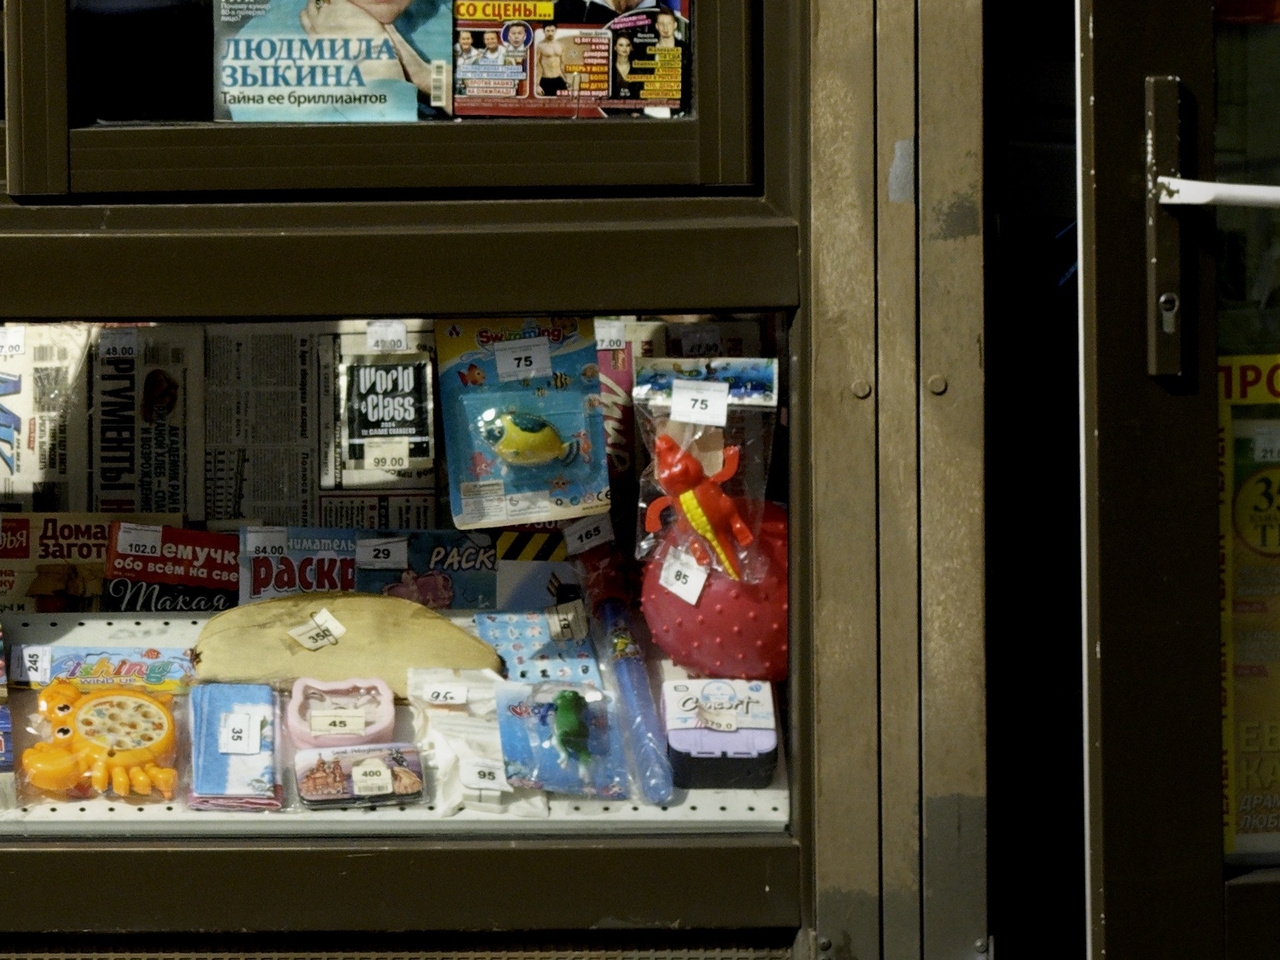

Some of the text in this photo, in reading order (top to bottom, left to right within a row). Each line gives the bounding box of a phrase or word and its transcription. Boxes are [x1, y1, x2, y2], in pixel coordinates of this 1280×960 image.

[457, 2, 552, 21] СО СЦЕНЫ...
[221, 38, 399, 64] ЛЮДМИЛА
[221, 65, 366, 88] ЗЫКИНА
[221, 91, 387, 107] Тайна ее бриллиантов
[514, 355, 534, 368] 75
[358, 365, 415, 395] World
[367, 395, 415, 422] Class
[690, 398, 709, 410] 75
[373, 456, 405, 467] 99.00
[577, 526, 602, 544] 165
[127, 543, 157, 555] 102.0
[372, 548, 391, 560] 29
[114, 558, 208, 578] обо всём на
[673, 570, 690, 586] 85
[27, 653, 39, 673] 245
[49, 653, 174, 685] Fishing
[328, 720, 348, 728] 45
[232, 727, 243, 742] 35
[361, 769, 382, 778] 400
[476, 770, 496, 780] 95
